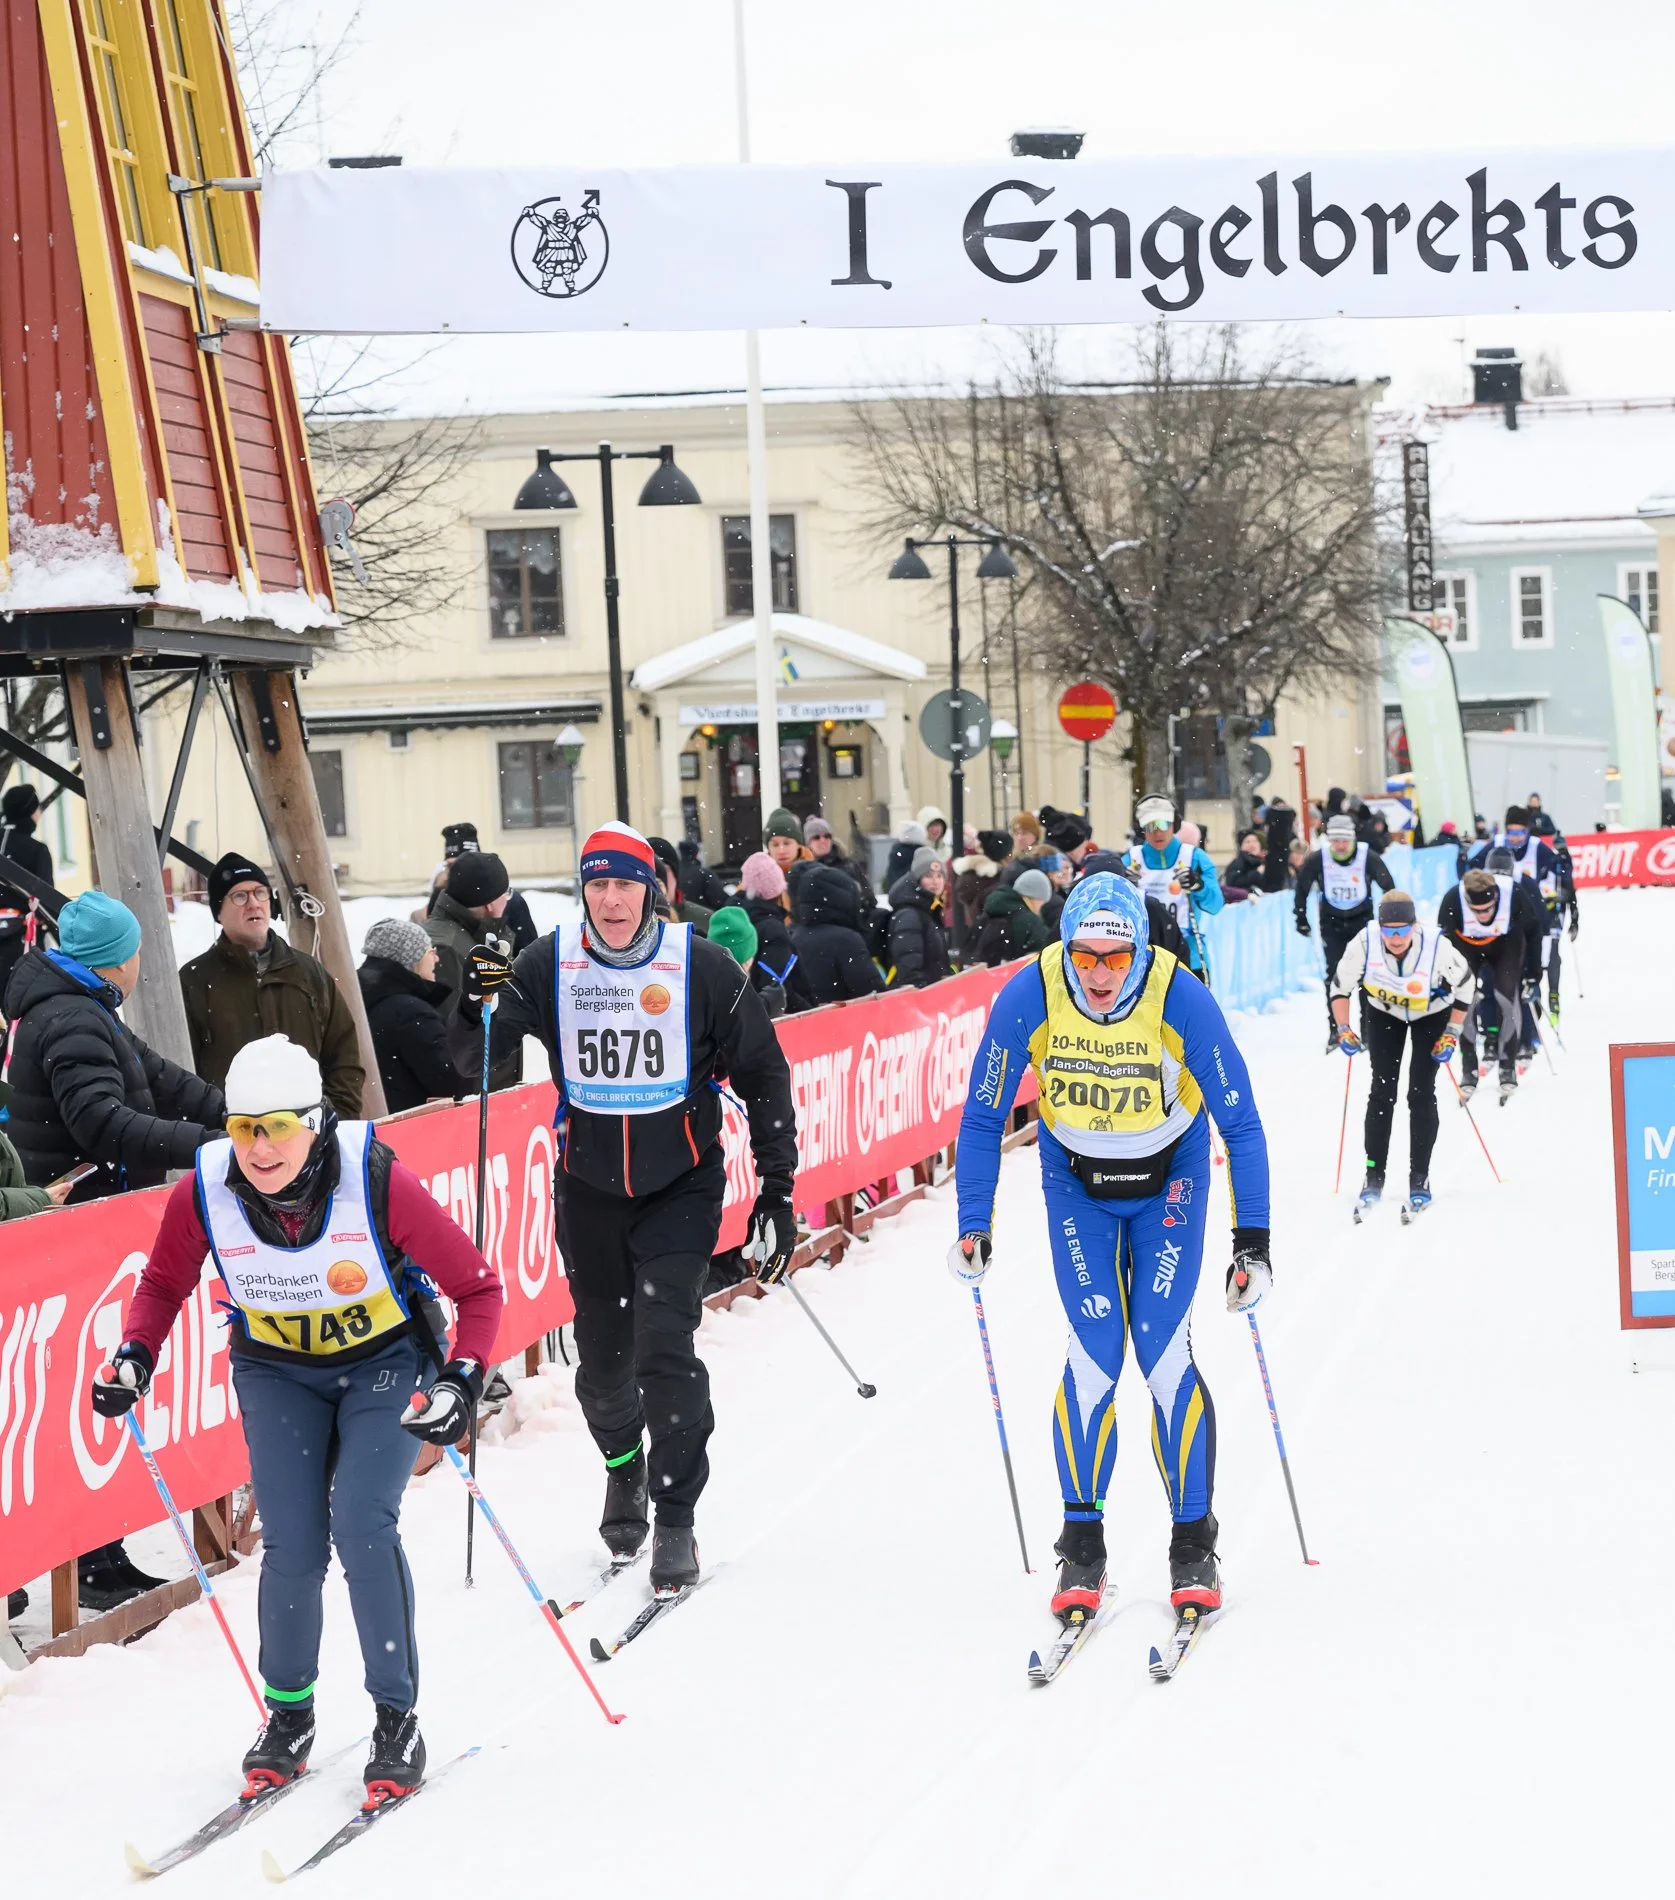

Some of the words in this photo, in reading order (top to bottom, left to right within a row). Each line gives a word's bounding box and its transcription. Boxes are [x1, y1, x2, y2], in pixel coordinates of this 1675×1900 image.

[825, 179, 892, 290] I
[962, 166, 1638, 312] Engelbrekts
[1409, 446, 1433, 610] RESTAURANG
[1571, 841, 1639, 880] ERVIT
[570, 984, 634, 998] Sparbanken
[575, 999, 634, 1013] Bergslagen
[1377, 989, 1410, 1008] 944
[577, 1028, 665, 1079] 5679
[1052, 1034, 1148, 1058] 20-KLUBBEN
[975, 1038, 1002, 1106] Structor
[1052, 1058, 1101, 1074] Jan-Olav
[1050, 1077, 1152, 1113] 20076
[1062, 1216, 1077, 1237] VB
[1067, 1238, 1092, 1287] ENERGI
[236, 1272, 319, 1288] Sparbanken
[245, 1287, 323, 1302] Bergslagen
[261, 1304, 373, 1352] 1743
